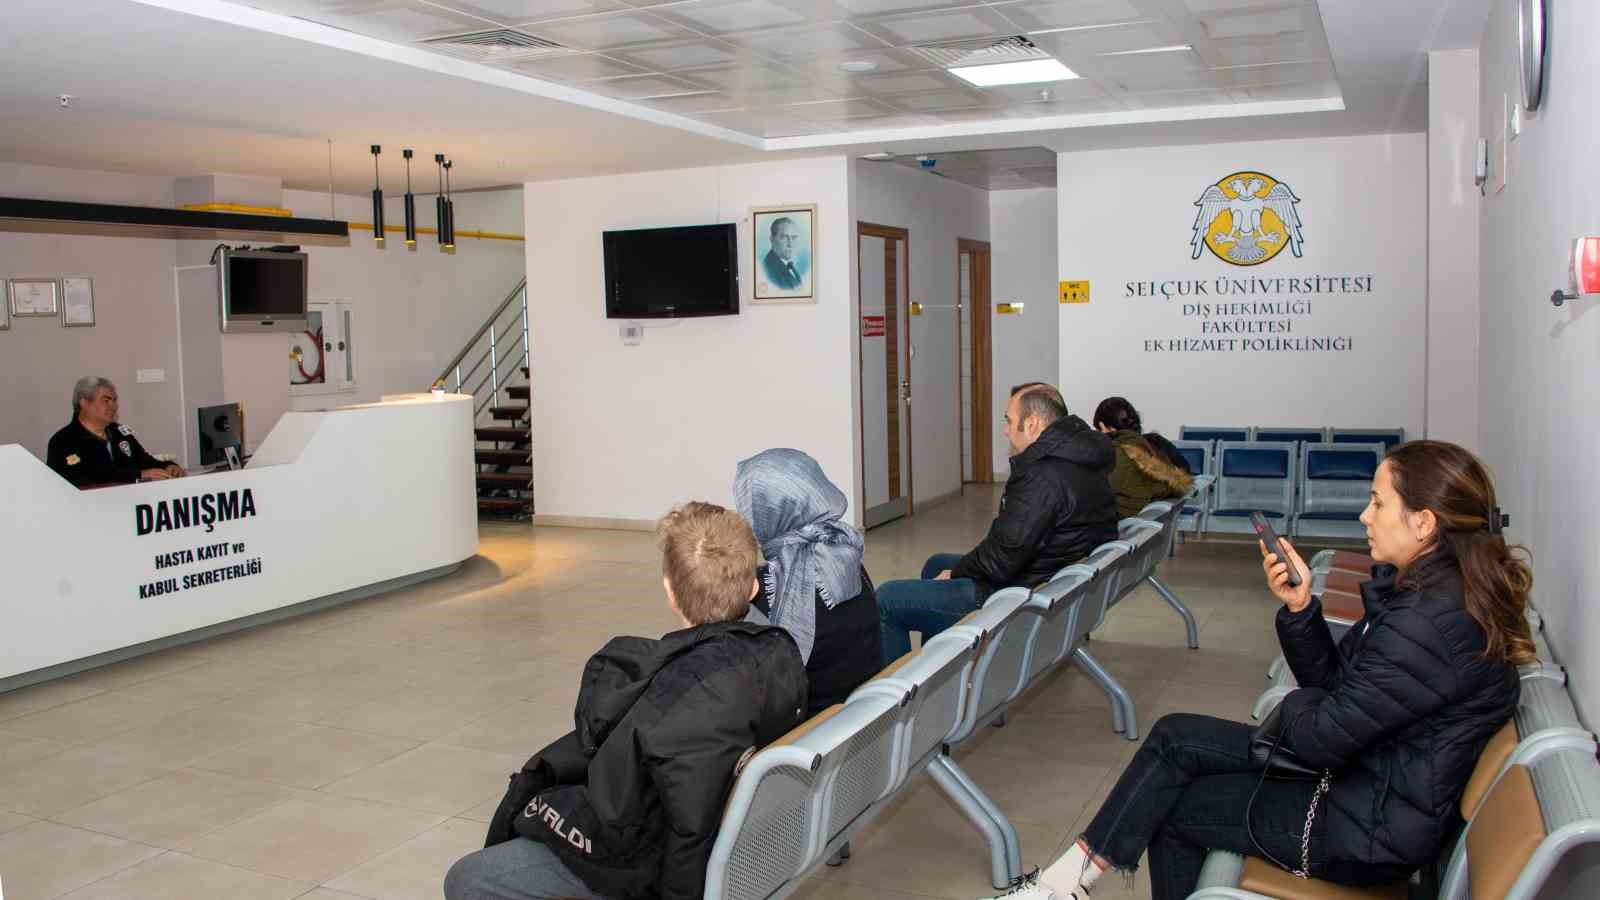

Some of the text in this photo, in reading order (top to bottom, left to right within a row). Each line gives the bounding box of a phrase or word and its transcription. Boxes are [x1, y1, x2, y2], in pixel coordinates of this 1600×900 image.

[1125, 274, 1372, 300] SELÇUK ÜNİVERSİTESİ
[1183, 300, 1312, 319] DİŞ HEKİMLİĞİ
[1202, 319, 1292, 334] FAKÜLTESİ
[1143, 336, 1353, 352] EK HİZMET POLİKLİNİĞİ
[135, 488, 256, 536] DANIŞMA
[155, 542, 245, 570] HASTA KAYIT ve
[139, 557, 262, 599] KABUL SEKRETERLİĞİ
